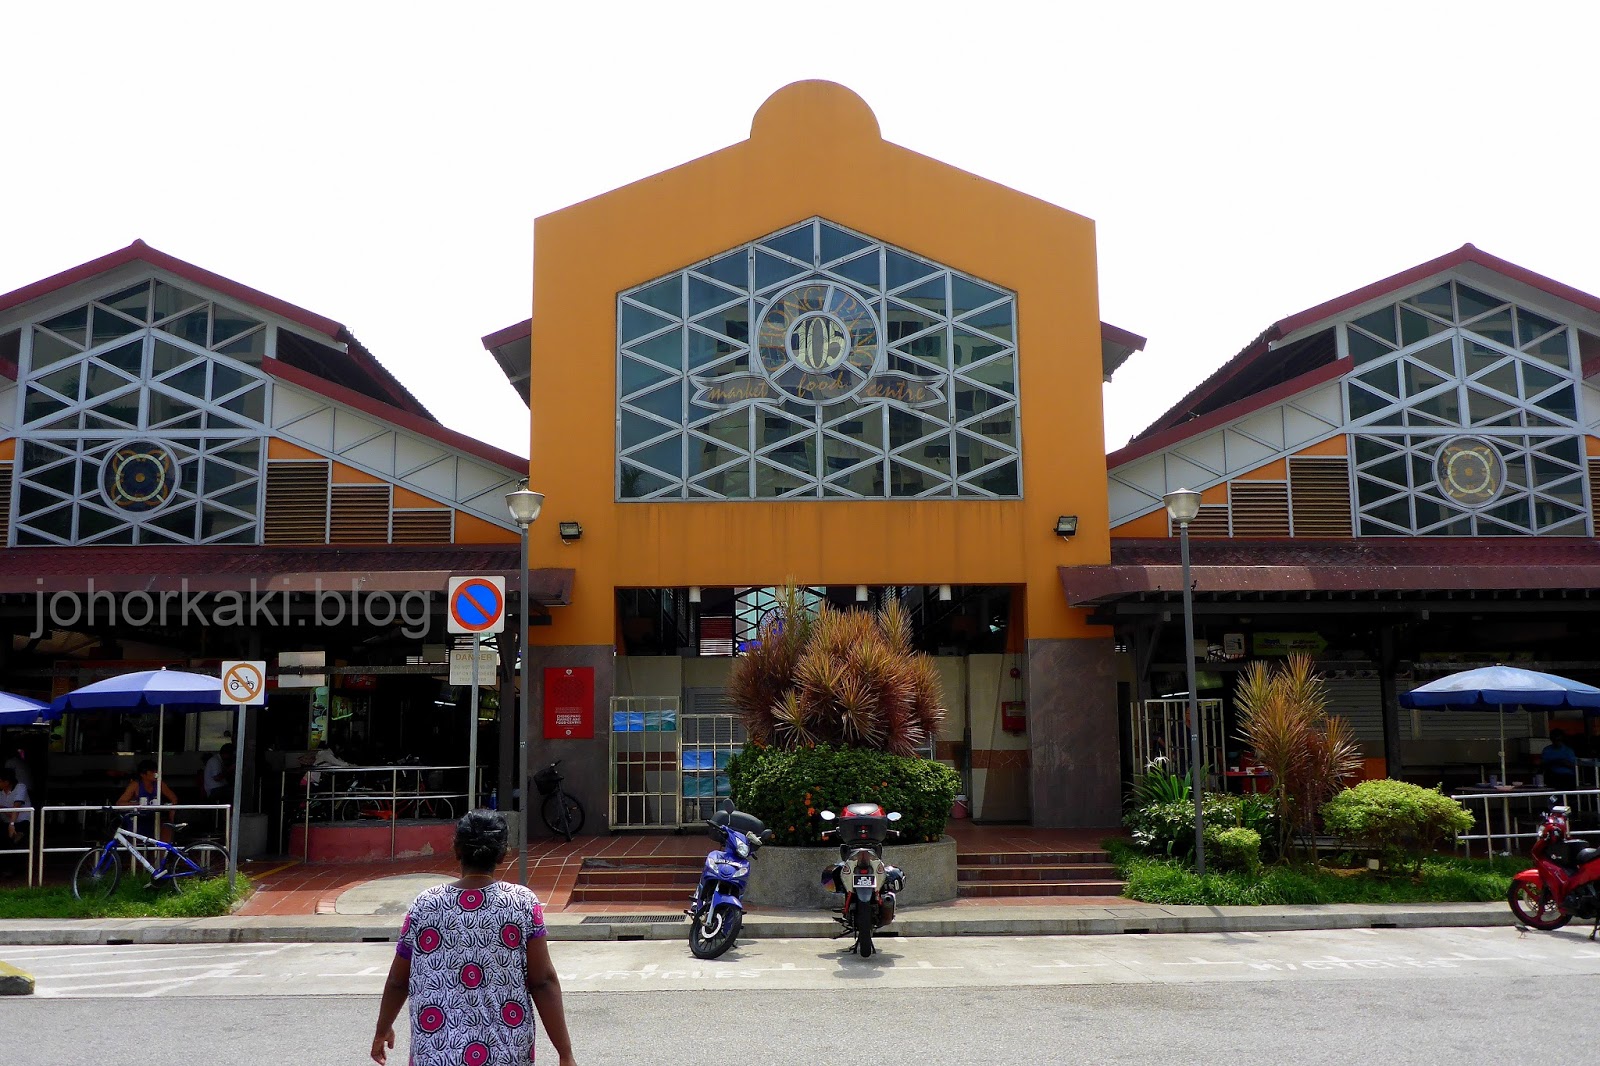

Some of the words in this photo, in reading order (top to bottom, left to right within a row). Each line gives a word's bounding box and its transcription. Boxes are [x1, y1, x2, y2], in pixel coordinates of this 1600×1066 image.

[790, 317, 847, 370] 105
[796, 371, 846, 399] food
[865, 380, 926, 401] centre
[455, 653, 493, 661] DANER
